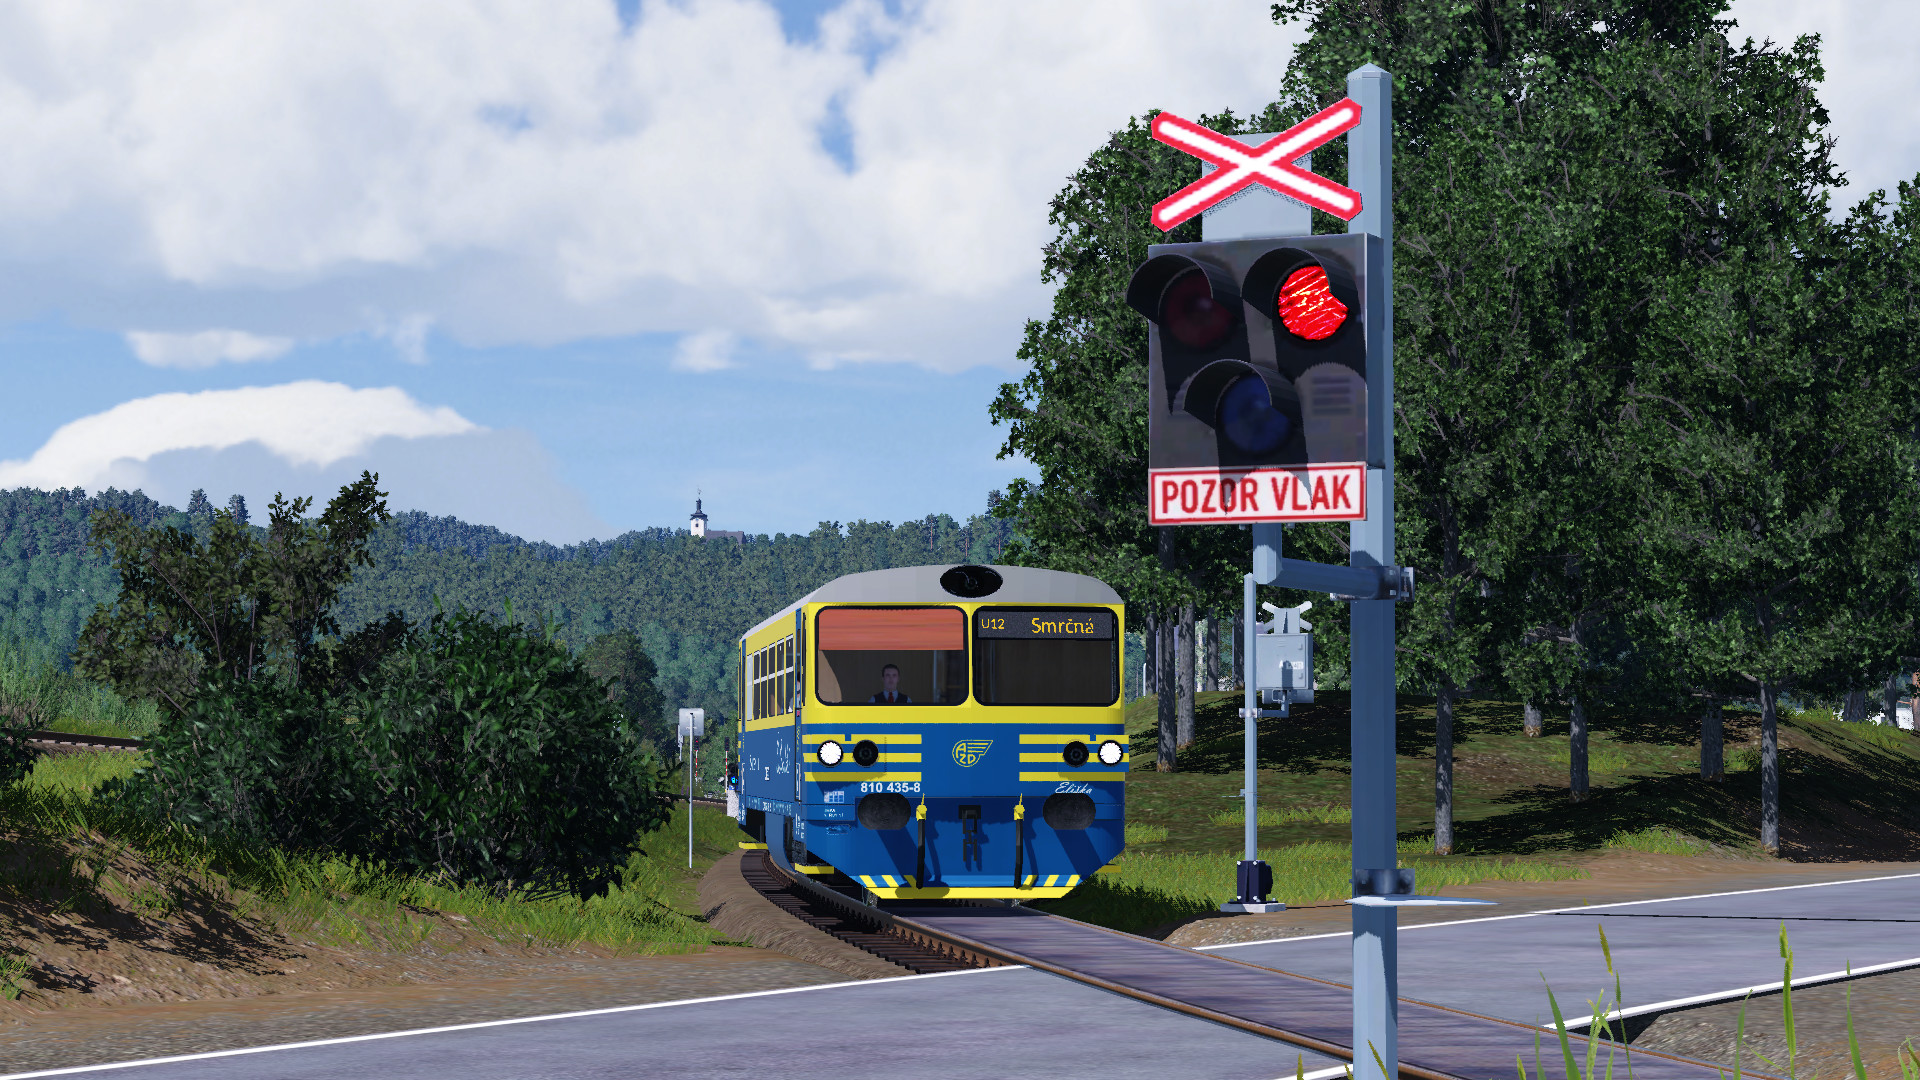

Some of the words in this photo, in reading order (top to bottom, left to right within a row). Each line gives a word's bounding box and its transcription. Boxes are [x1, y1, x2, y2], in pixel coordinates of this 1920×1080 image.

[1162, 478, 1259, 513] POZOR
[1271, 474, 1351, 511] VLAK
[981, 618, 1005, 630] U12
[1031, 617, 1094, 634] Smrčná
[860, 782, 883, 793] 810
[886, 782, 921, 793] 435-8
